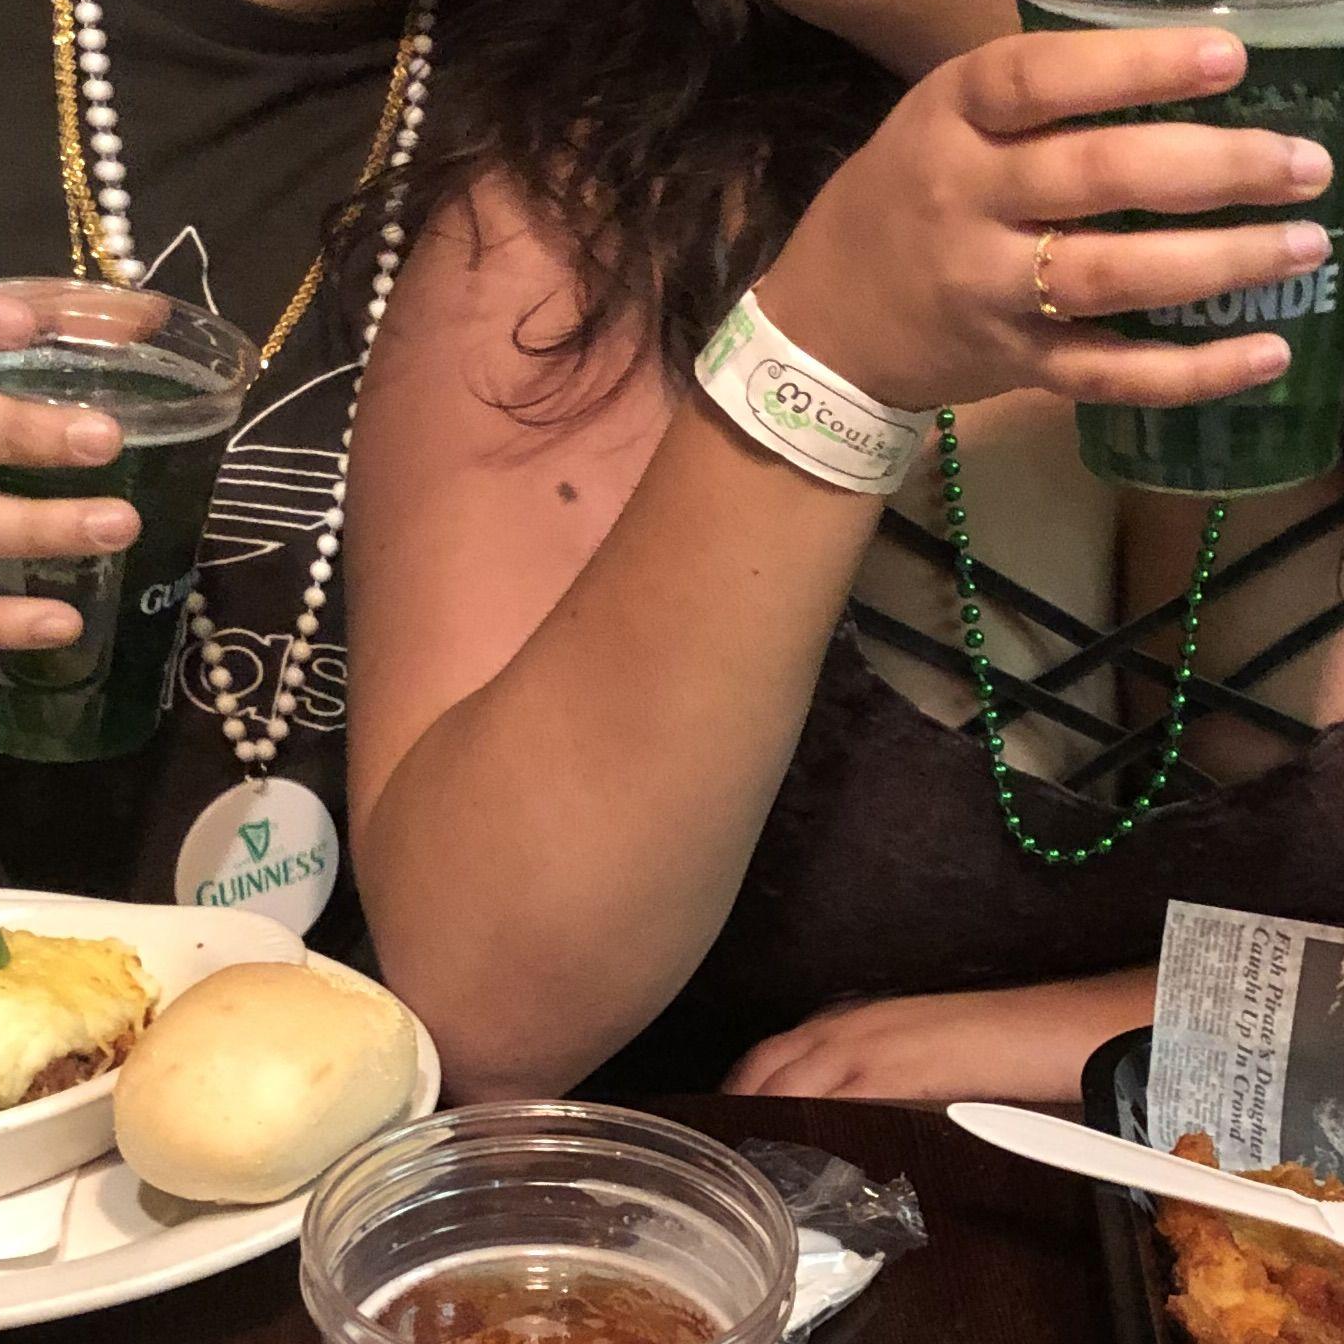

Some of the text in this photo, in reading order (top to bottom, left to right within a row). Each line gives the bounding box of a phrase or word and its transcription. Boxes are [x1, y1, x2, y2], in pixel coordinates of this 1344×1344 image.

[195, 846, 326, 906] GUINNESS
[1228, 927, 1270, 1145] Caught Up In Crowd
[1247, 930, 1292, 1164] Fish Pirate's Daughter
